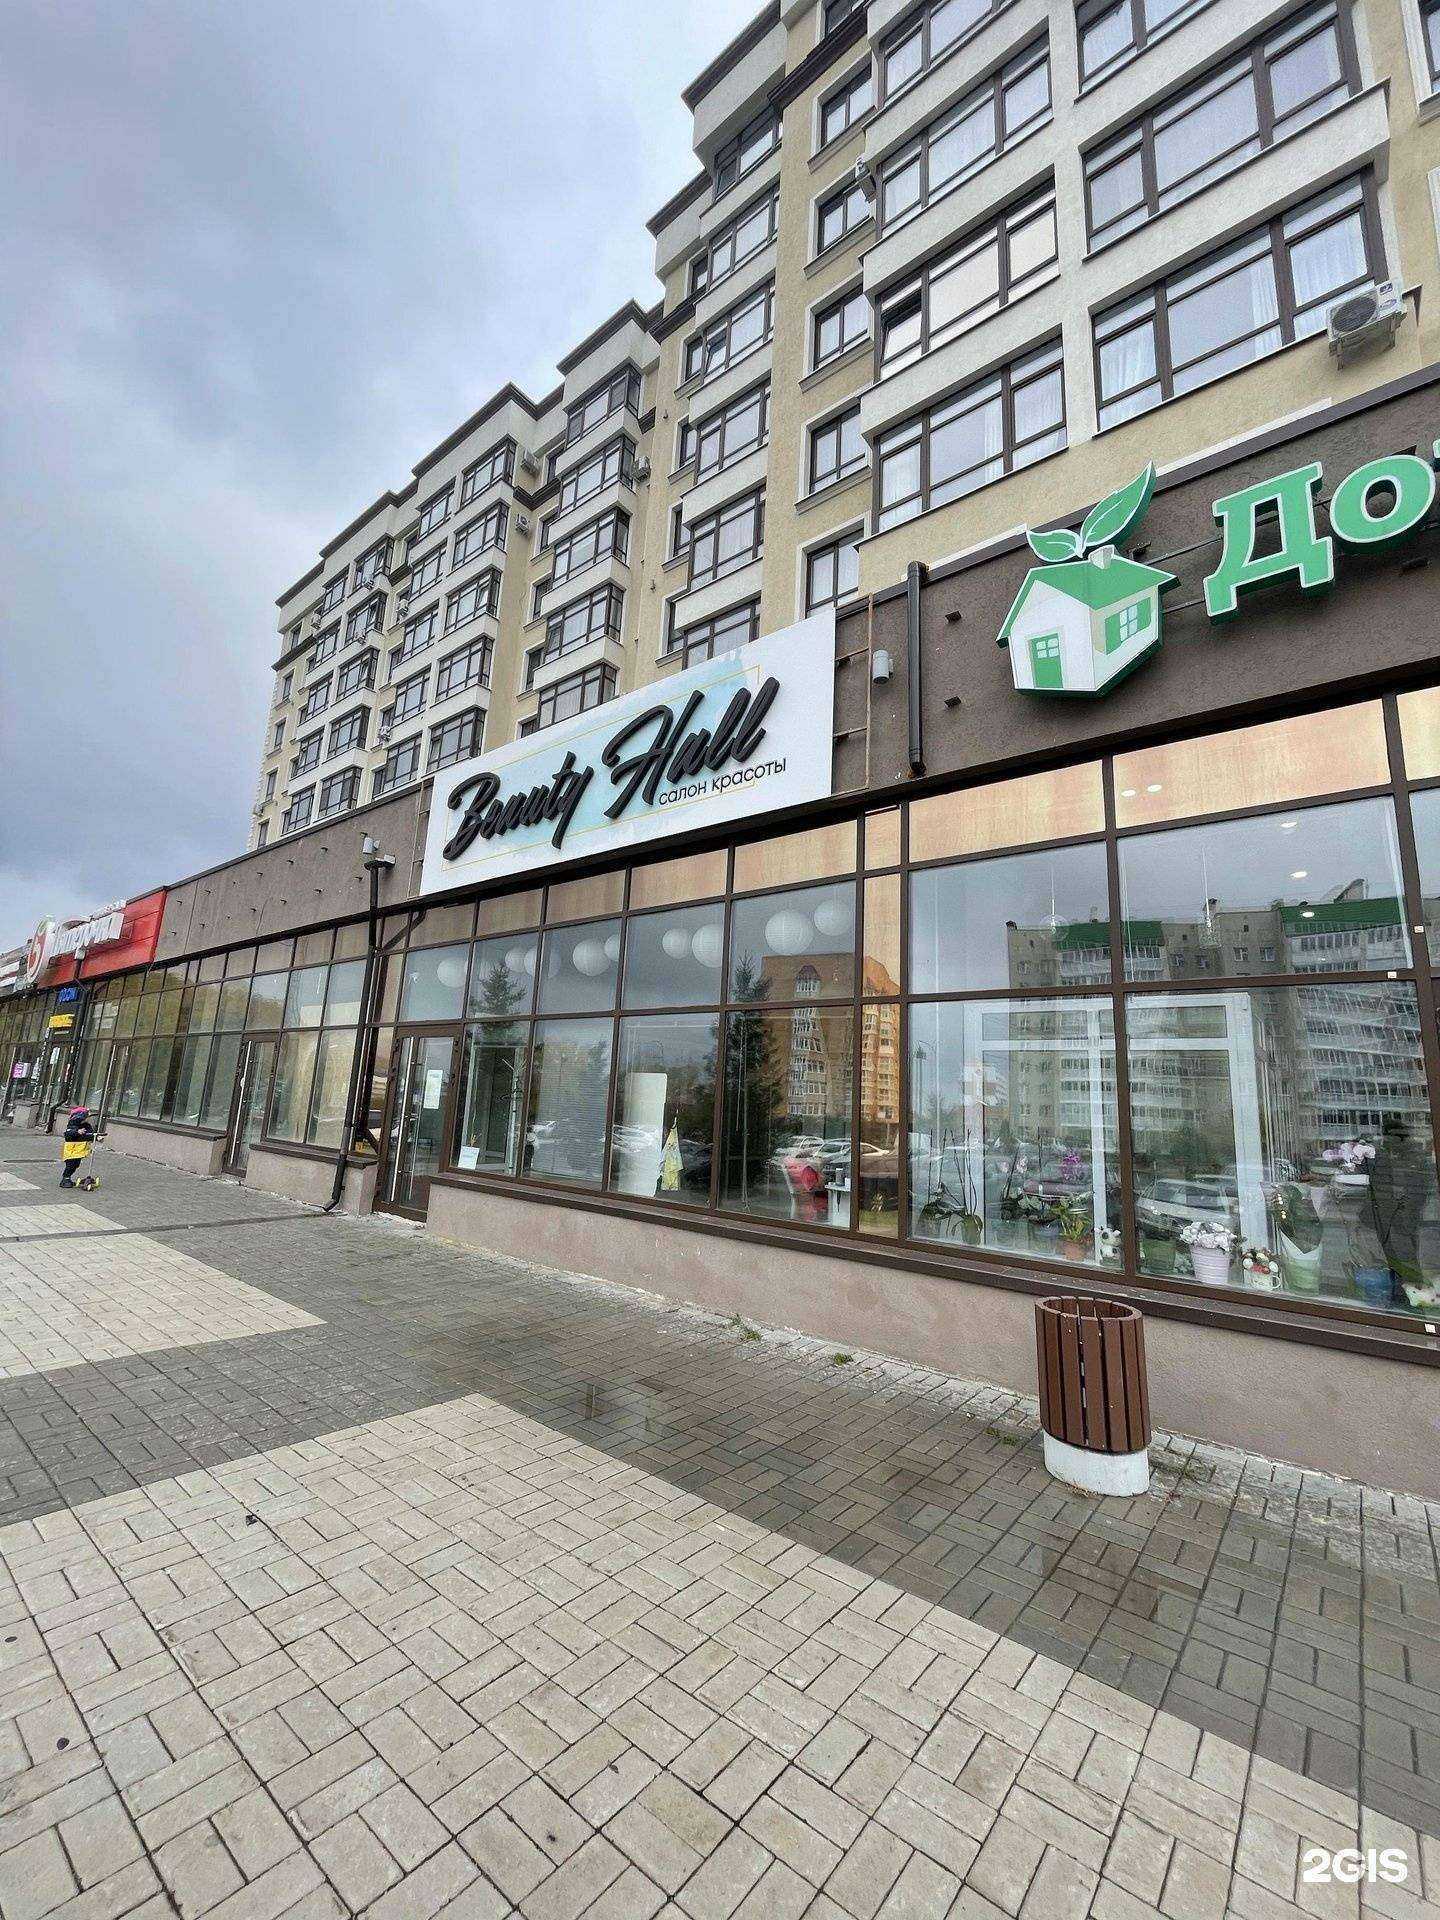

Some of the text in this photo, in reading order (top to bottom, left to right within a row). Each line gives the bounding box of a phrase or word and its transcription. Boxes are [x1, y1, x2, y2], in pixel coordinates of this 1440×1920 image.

[443, 676, 780, 861] Beauty Hall
[658, 757, 787, 807] салон красоты
